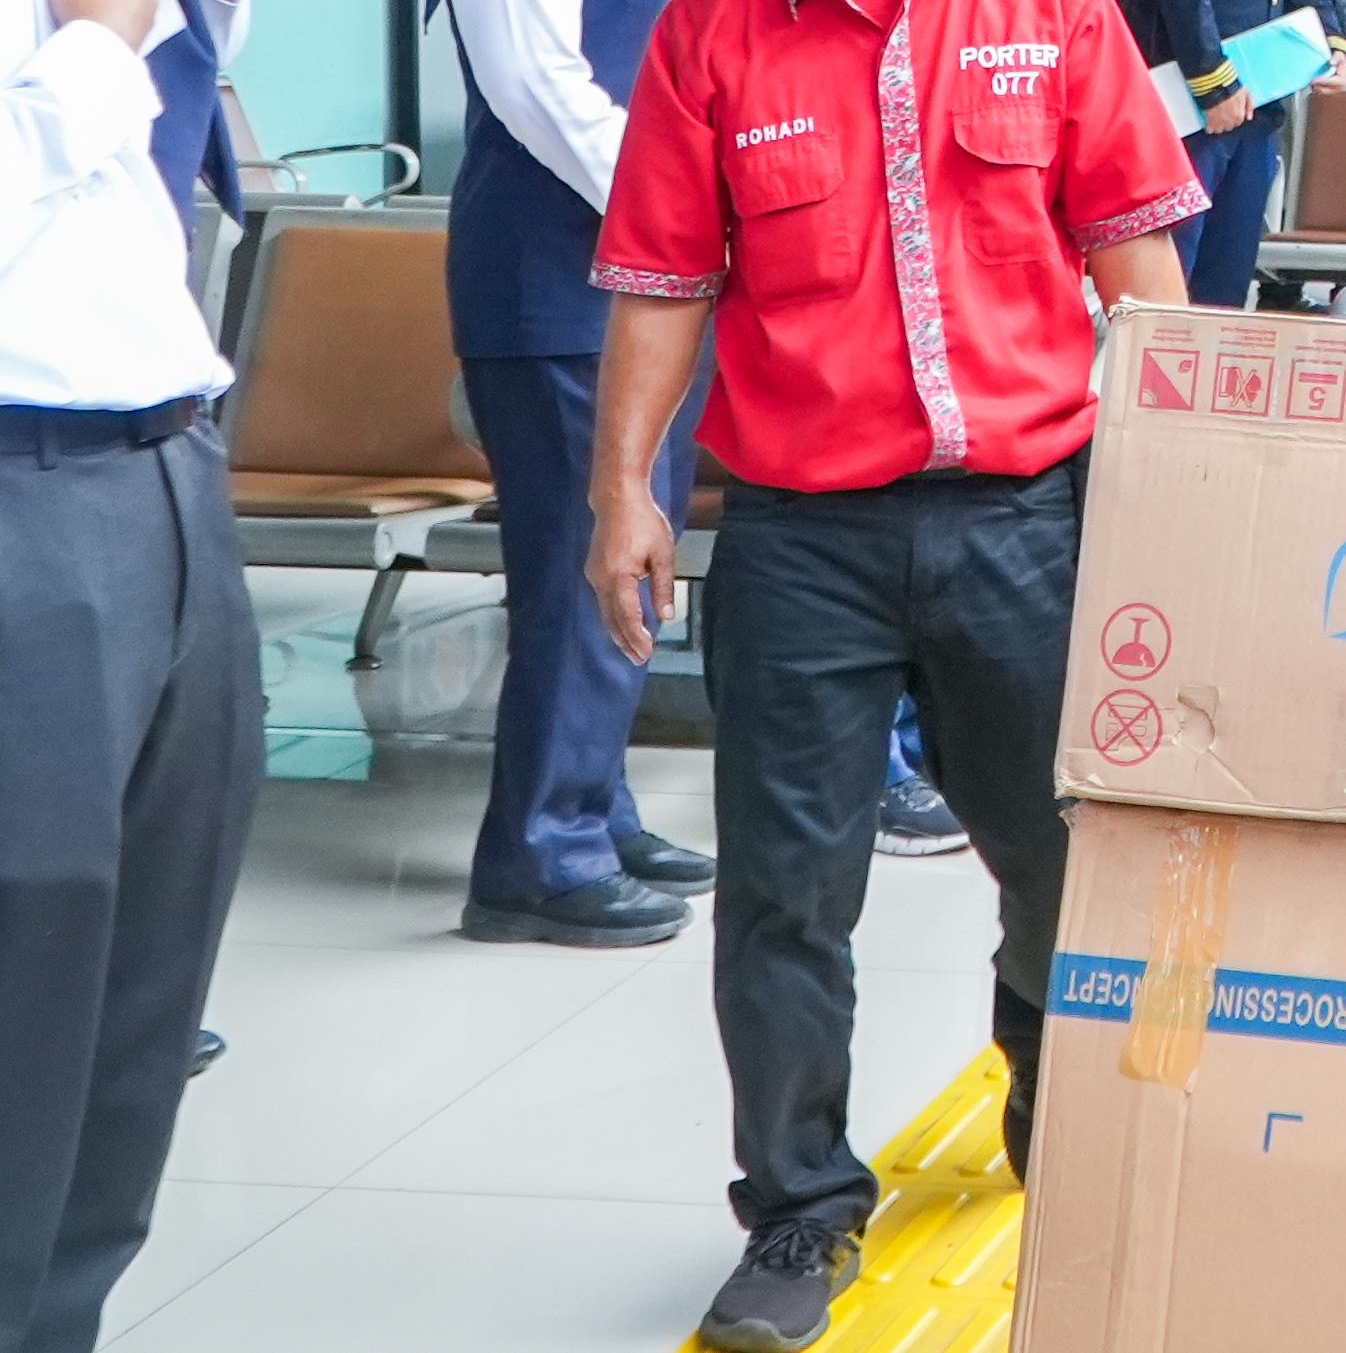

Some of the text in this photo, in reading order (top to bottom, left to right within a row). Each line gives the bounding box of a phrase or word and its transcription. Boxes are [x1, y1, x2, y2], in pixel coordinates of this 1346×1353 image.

[958, 43, 1061, 71] PORTER
[991, 70, 1040, 97] 077
[735, 117, 815, 149] ROHADI
[1307, 385, 1327, 411] 5
[1063, 968, 1144, 1009] CEPT
